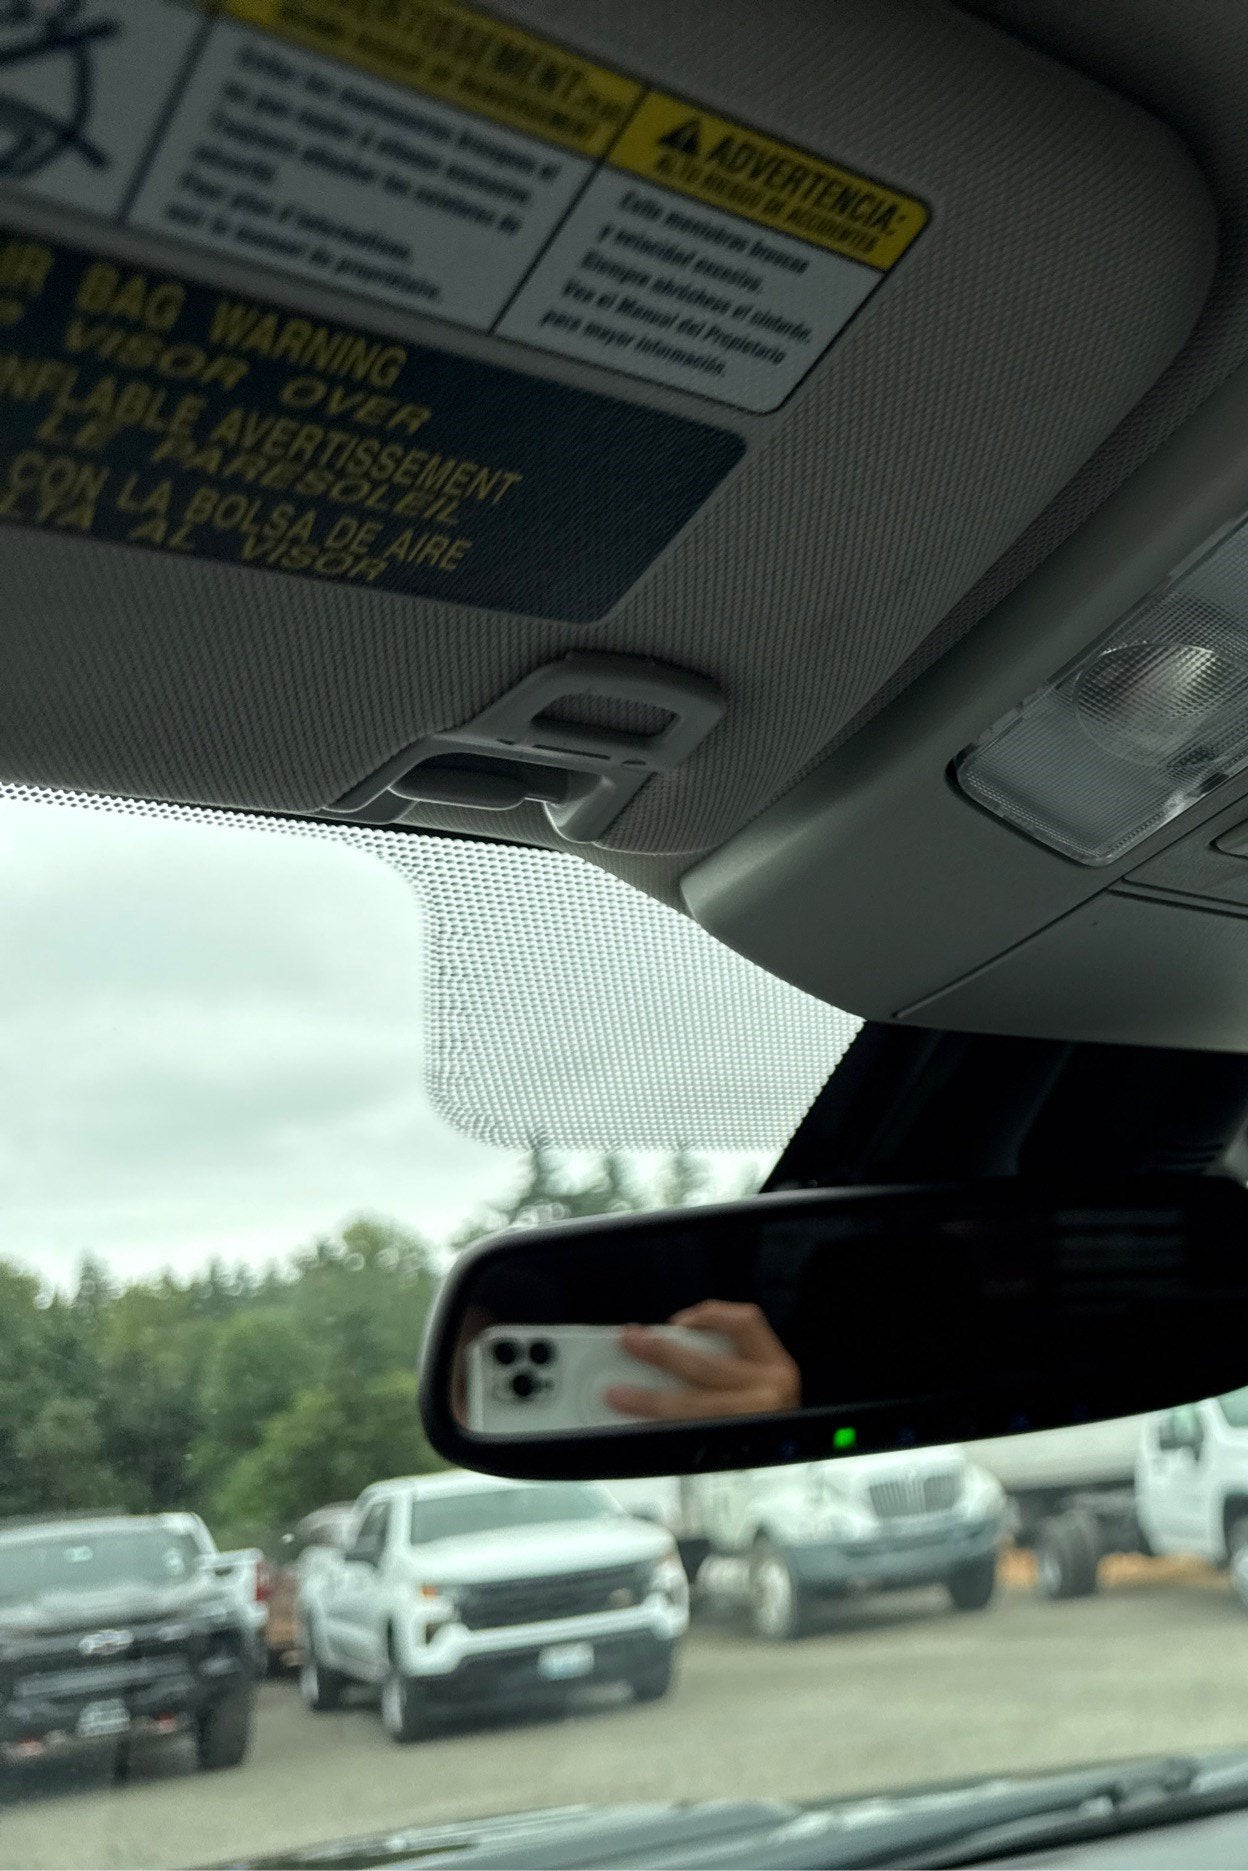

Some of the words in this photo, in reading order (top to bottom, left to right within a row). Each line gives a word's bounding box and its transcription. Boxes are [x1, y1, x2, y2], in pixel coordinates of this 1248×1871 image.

[0, 242, 53, 296] IR
[75, 261, 187, 333] BAG
[208, 301, 409, 391] WARNING
[278, 375, 433, 435] OVER
[211, 408, 524, 505] AVERTISSEMENT
[116, 471, 173, 513] LA
[184, 487, 318, 545] BOLSA
[327, 515, 385, 554] DE
[388, 528, 475, 573] AIRE
